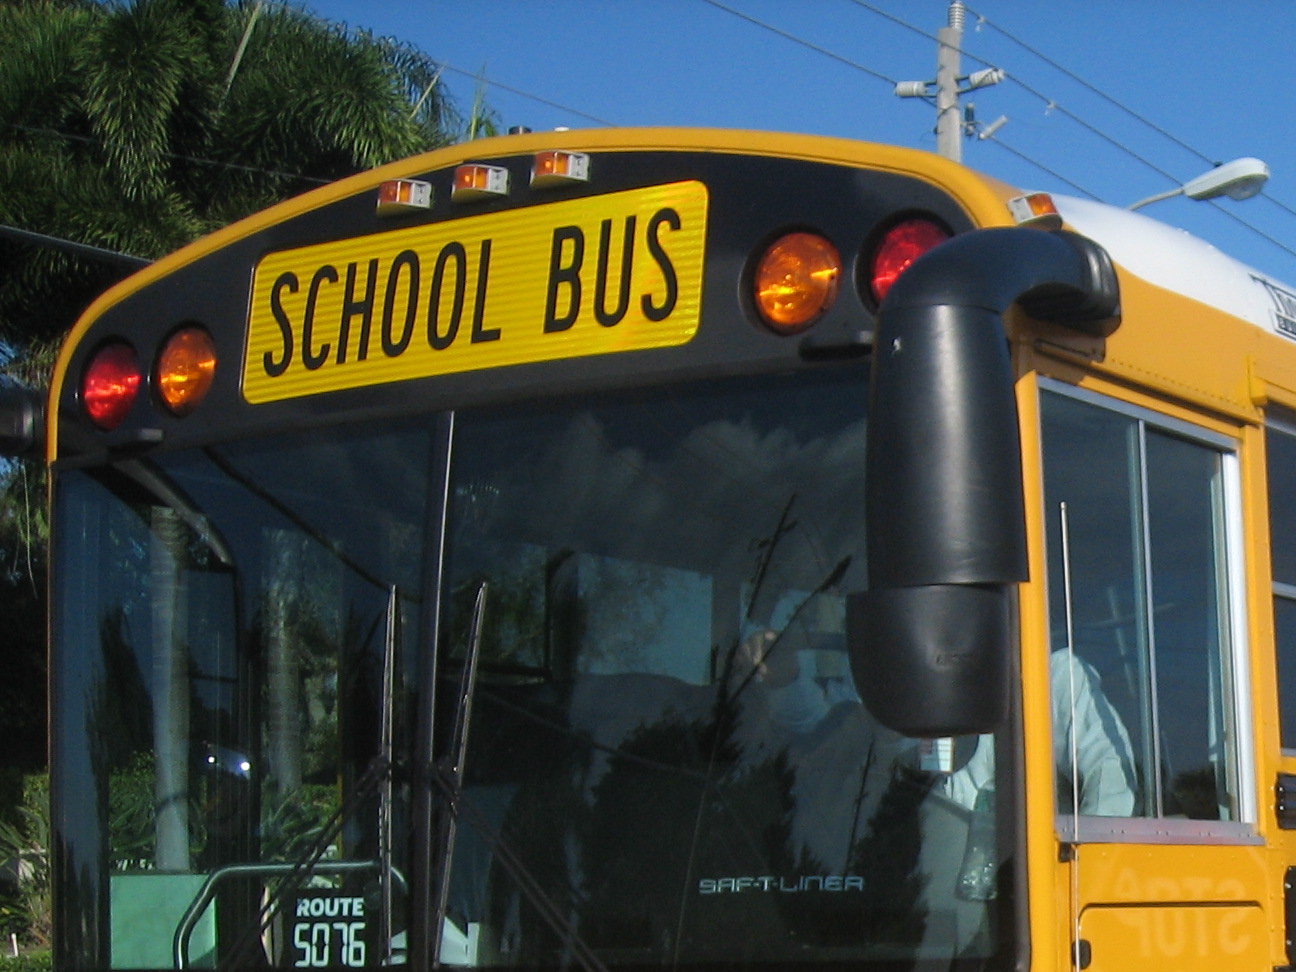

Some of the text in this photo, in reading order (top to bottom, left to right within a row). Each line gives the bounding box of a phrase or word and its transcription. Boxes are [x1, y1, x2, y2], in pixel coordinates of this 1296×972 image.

[263, 207, 681, 378] SCHOOL BUS
[296, 897, 365, 917] ROUTE
[294, 922, 366, 968] 5076
